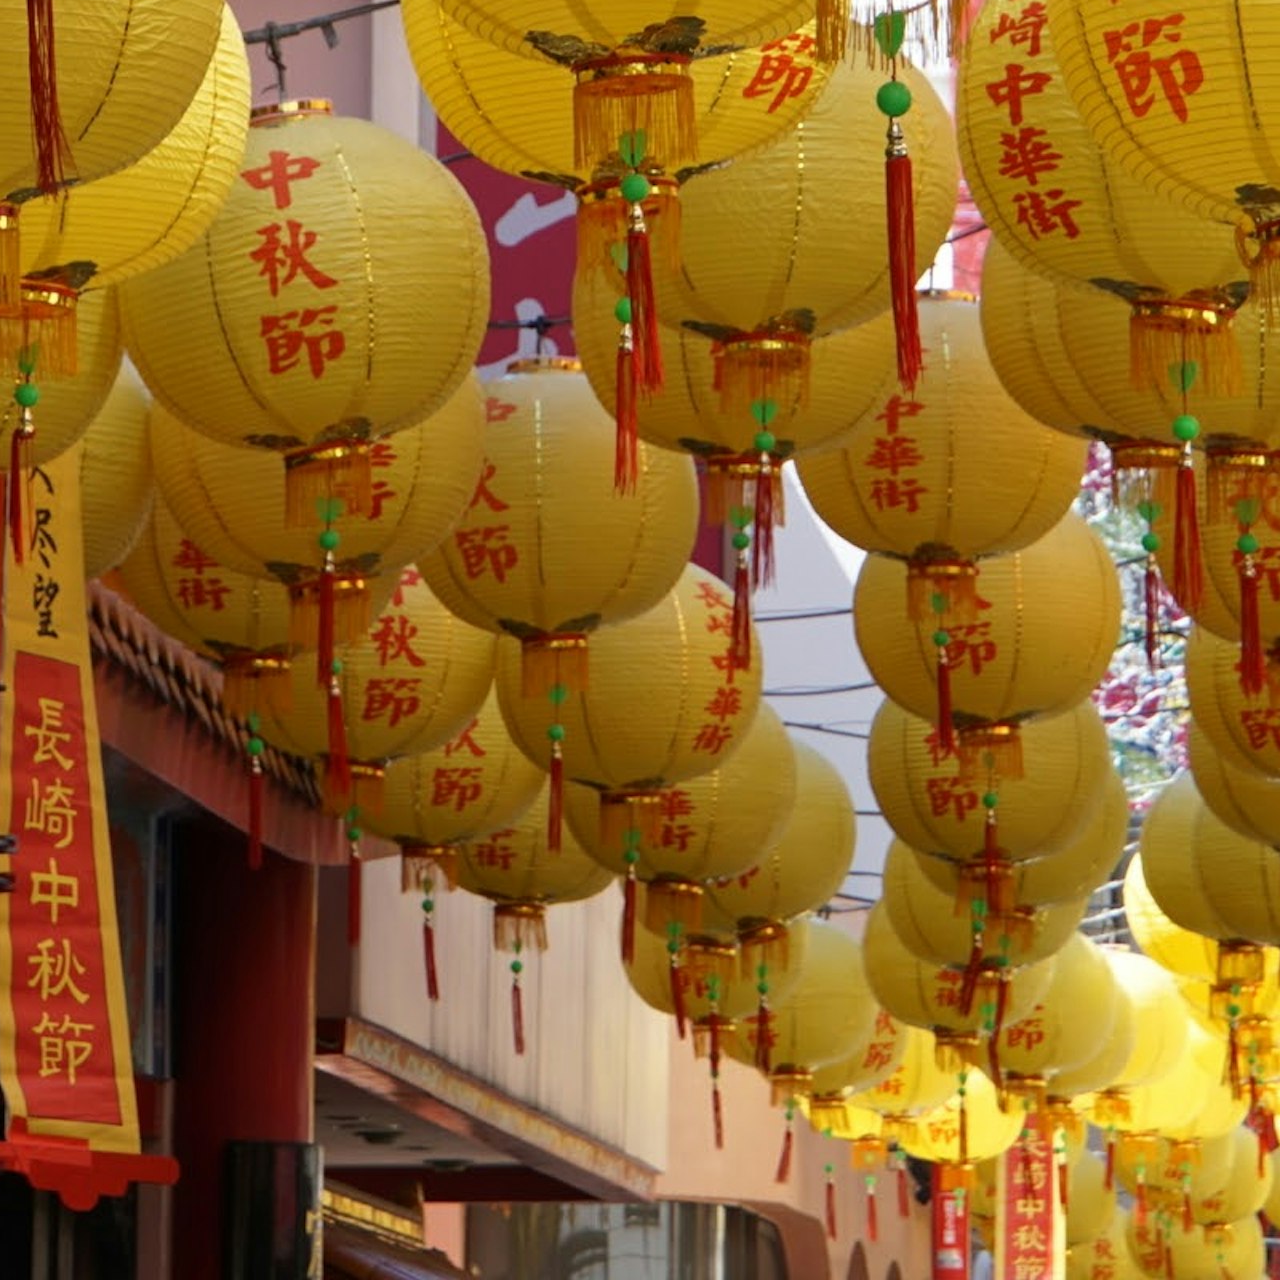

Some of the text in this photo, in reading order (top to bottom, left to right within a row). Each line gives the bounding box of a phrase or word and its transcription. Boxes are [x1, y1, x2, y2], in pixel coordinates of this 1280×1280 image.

[240, 150, 346, 380] 中秋節
[24, 697, 96, 1085] 長崎中秋節
